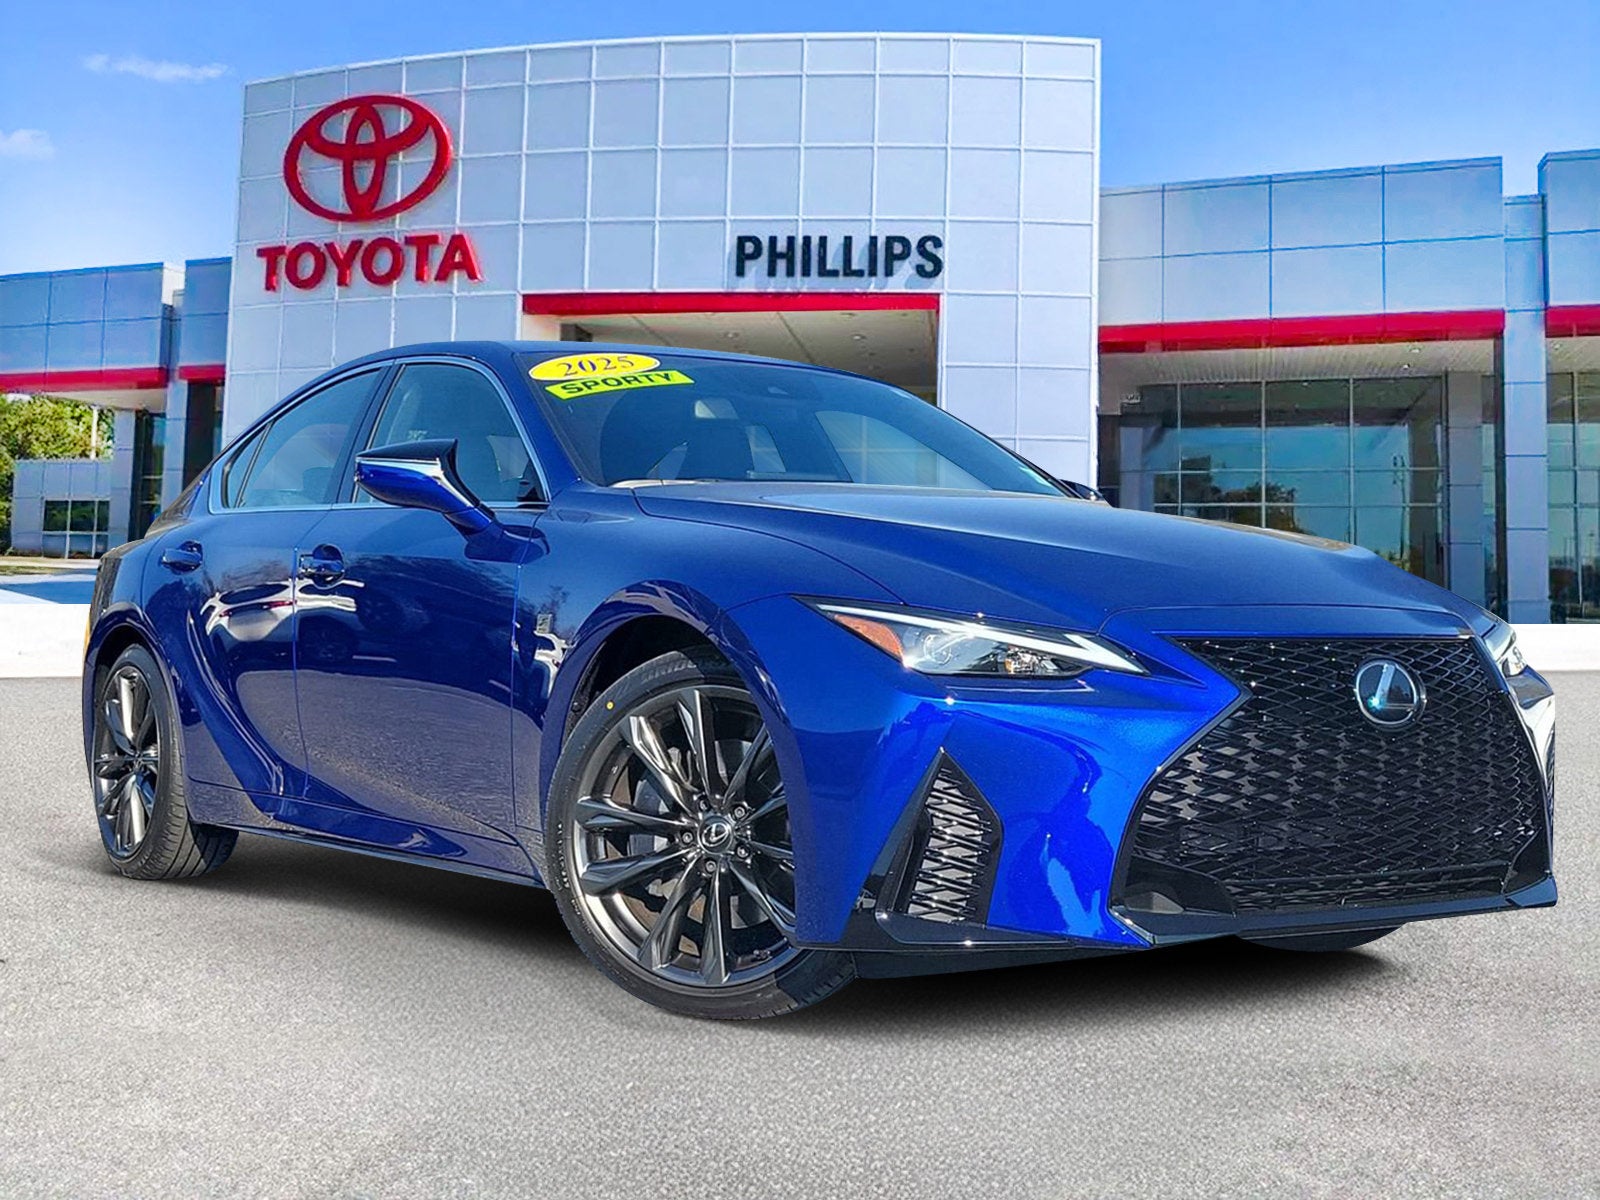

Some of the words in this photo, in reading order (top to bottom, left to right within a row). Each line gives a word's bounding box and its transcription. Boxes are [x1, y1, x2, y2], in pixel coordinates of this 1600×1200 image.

[256, 234, 482, 292] TOYOTA
[736, 235, 943, 279] PHILLIPS
[557, 356, 634, 376] 2025
[561, 372, 673, 394] SPORTY
